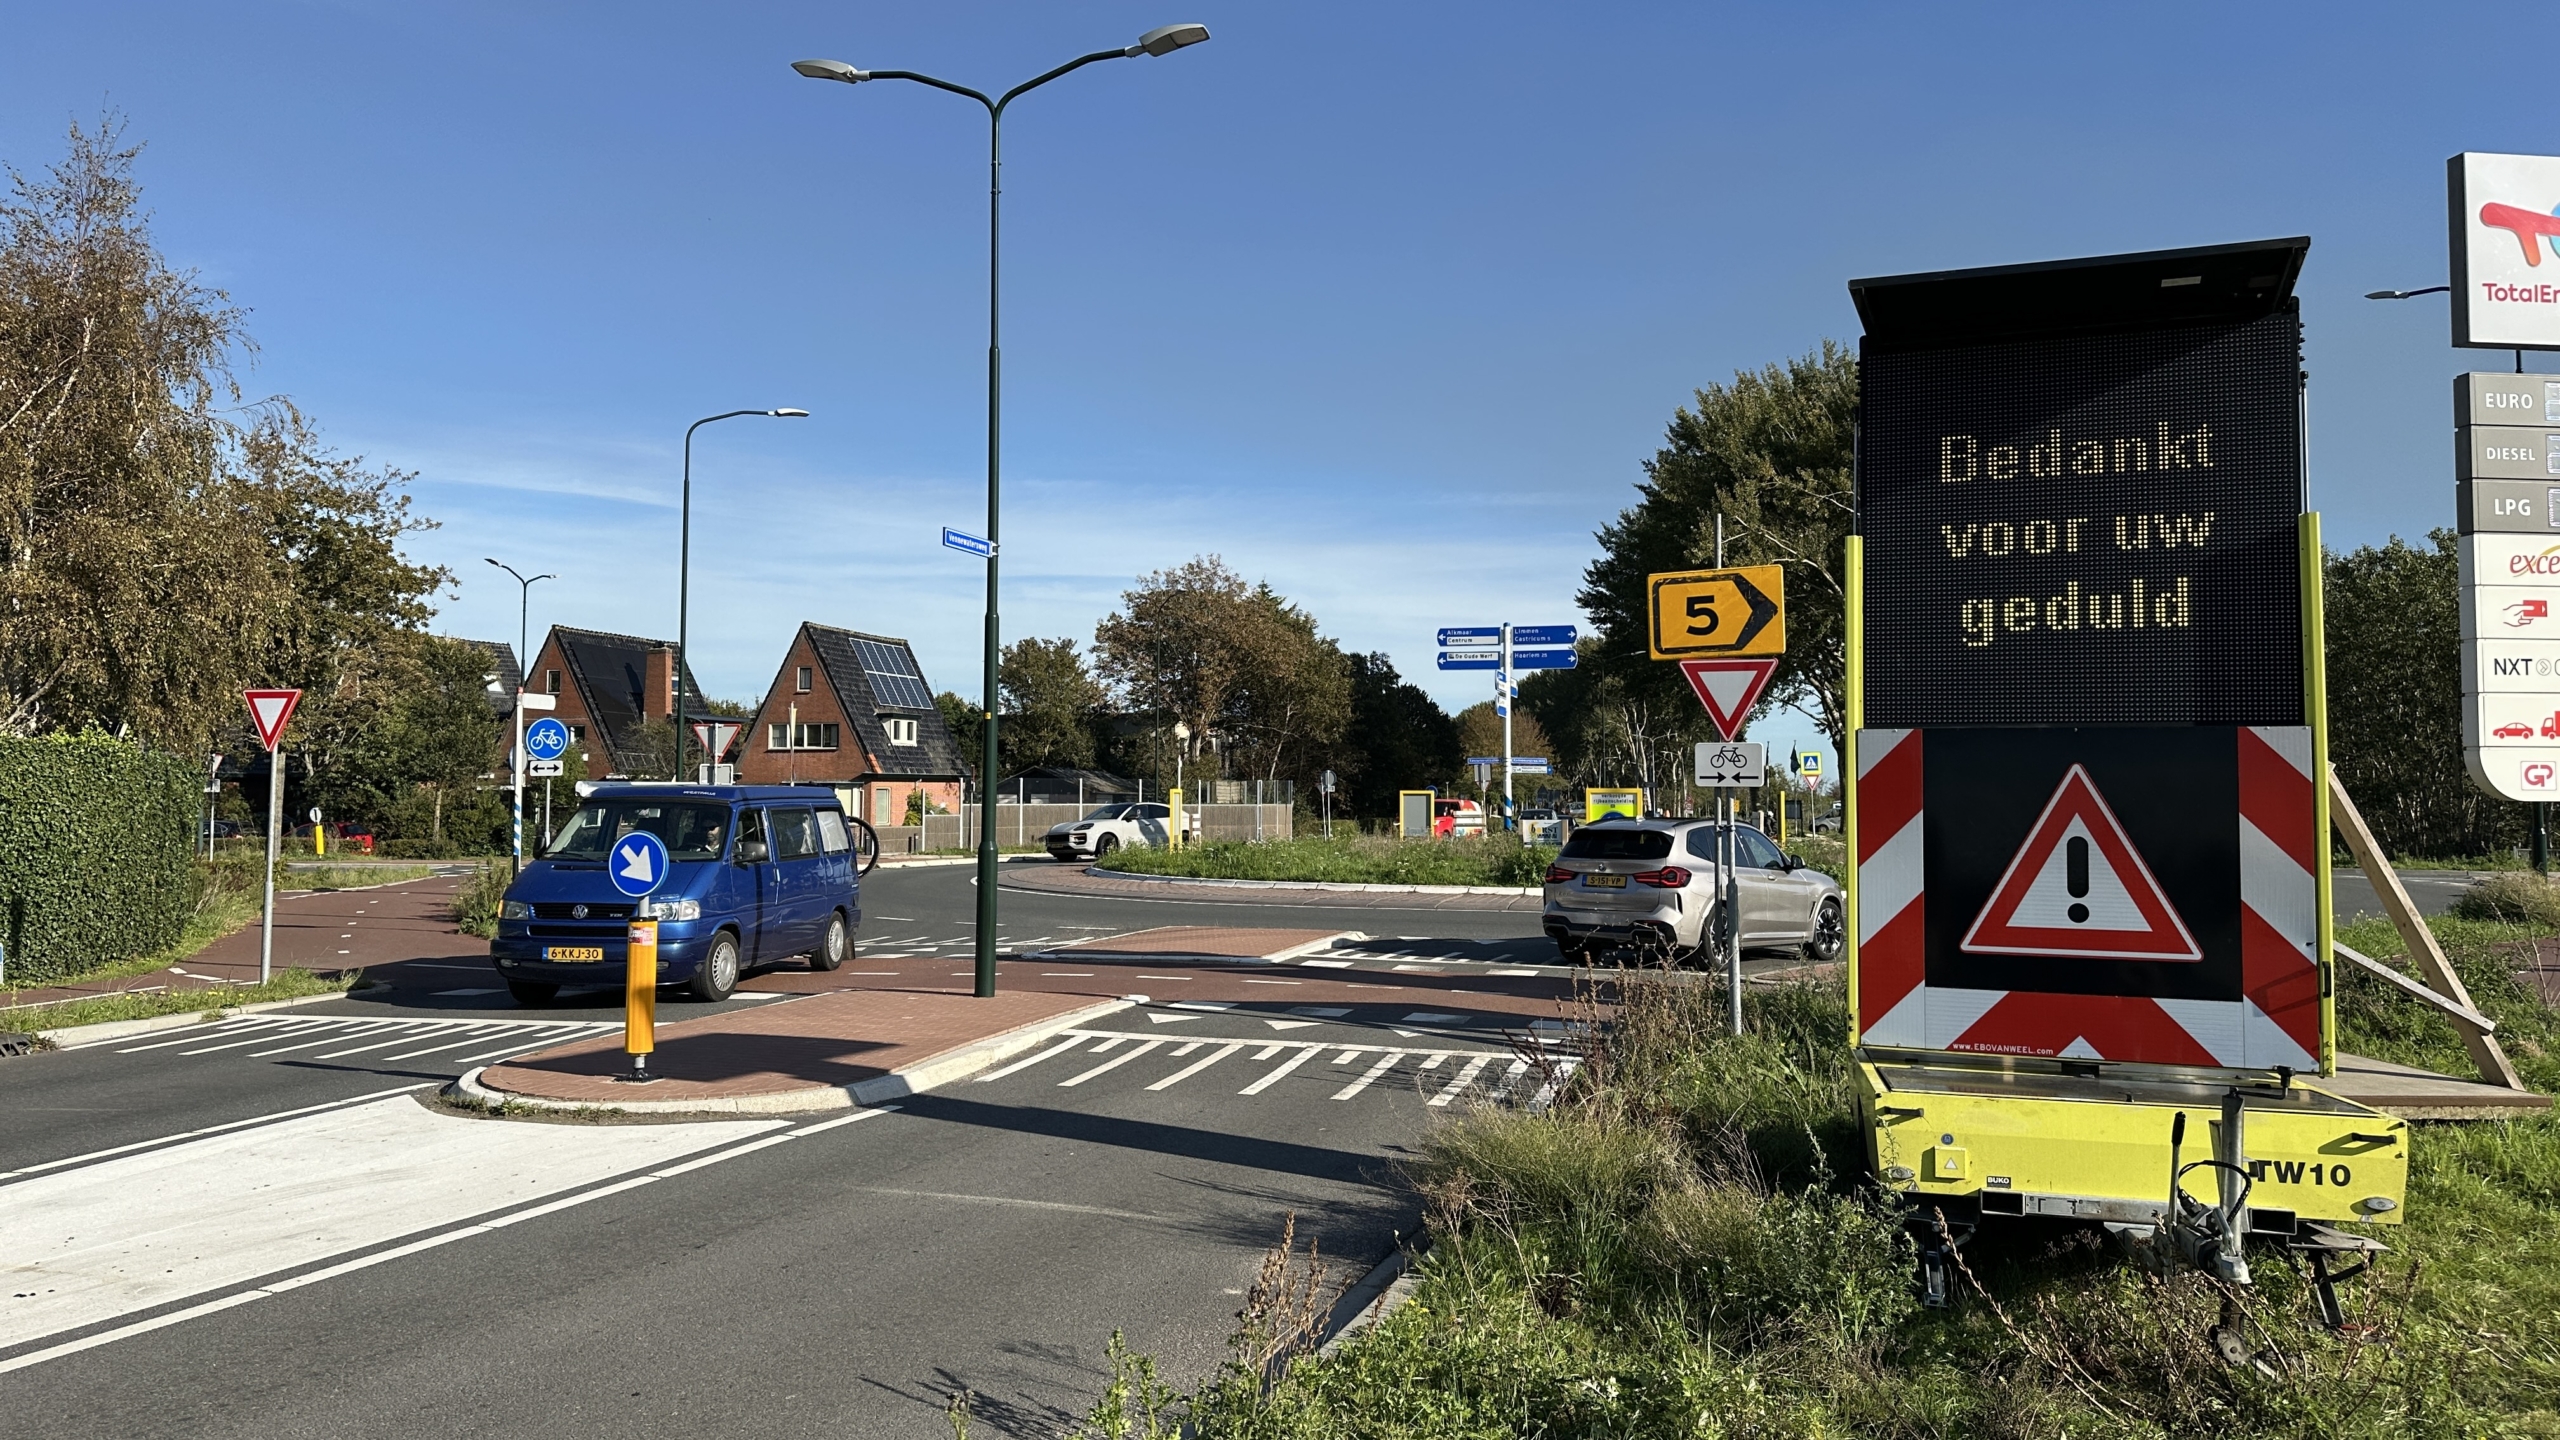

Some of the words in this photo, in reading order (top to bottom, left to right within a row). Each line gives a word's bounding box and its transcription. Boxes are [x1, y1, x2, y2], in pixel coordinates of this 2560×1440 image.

[2485, 392, 2533, 409] EURO
[1941, 421, 2213, 483] Bedankt
[2486, 447, 2536, 461] DIESEL
[2494, 498, 2531, 516] LPG
[1941, 517, 2088, 557] voor
[2115, 511, 2214, 550] uw
[1686, 595, 1719, 636] 5
[1962, 577, 2189, 647] geduld
[2494, 658, 2533, 676] NXT
[1590, 876, 1621, 885] S-151-VP
[551, 948, 599, 959] 6-KKJ-30
[1952, 1043, 2054, 1055] www.EBOVANWEEL.com
[1987, 1177, 2010, 1185] BUKO
[2254, 1160, 2351, 1187] TW10
